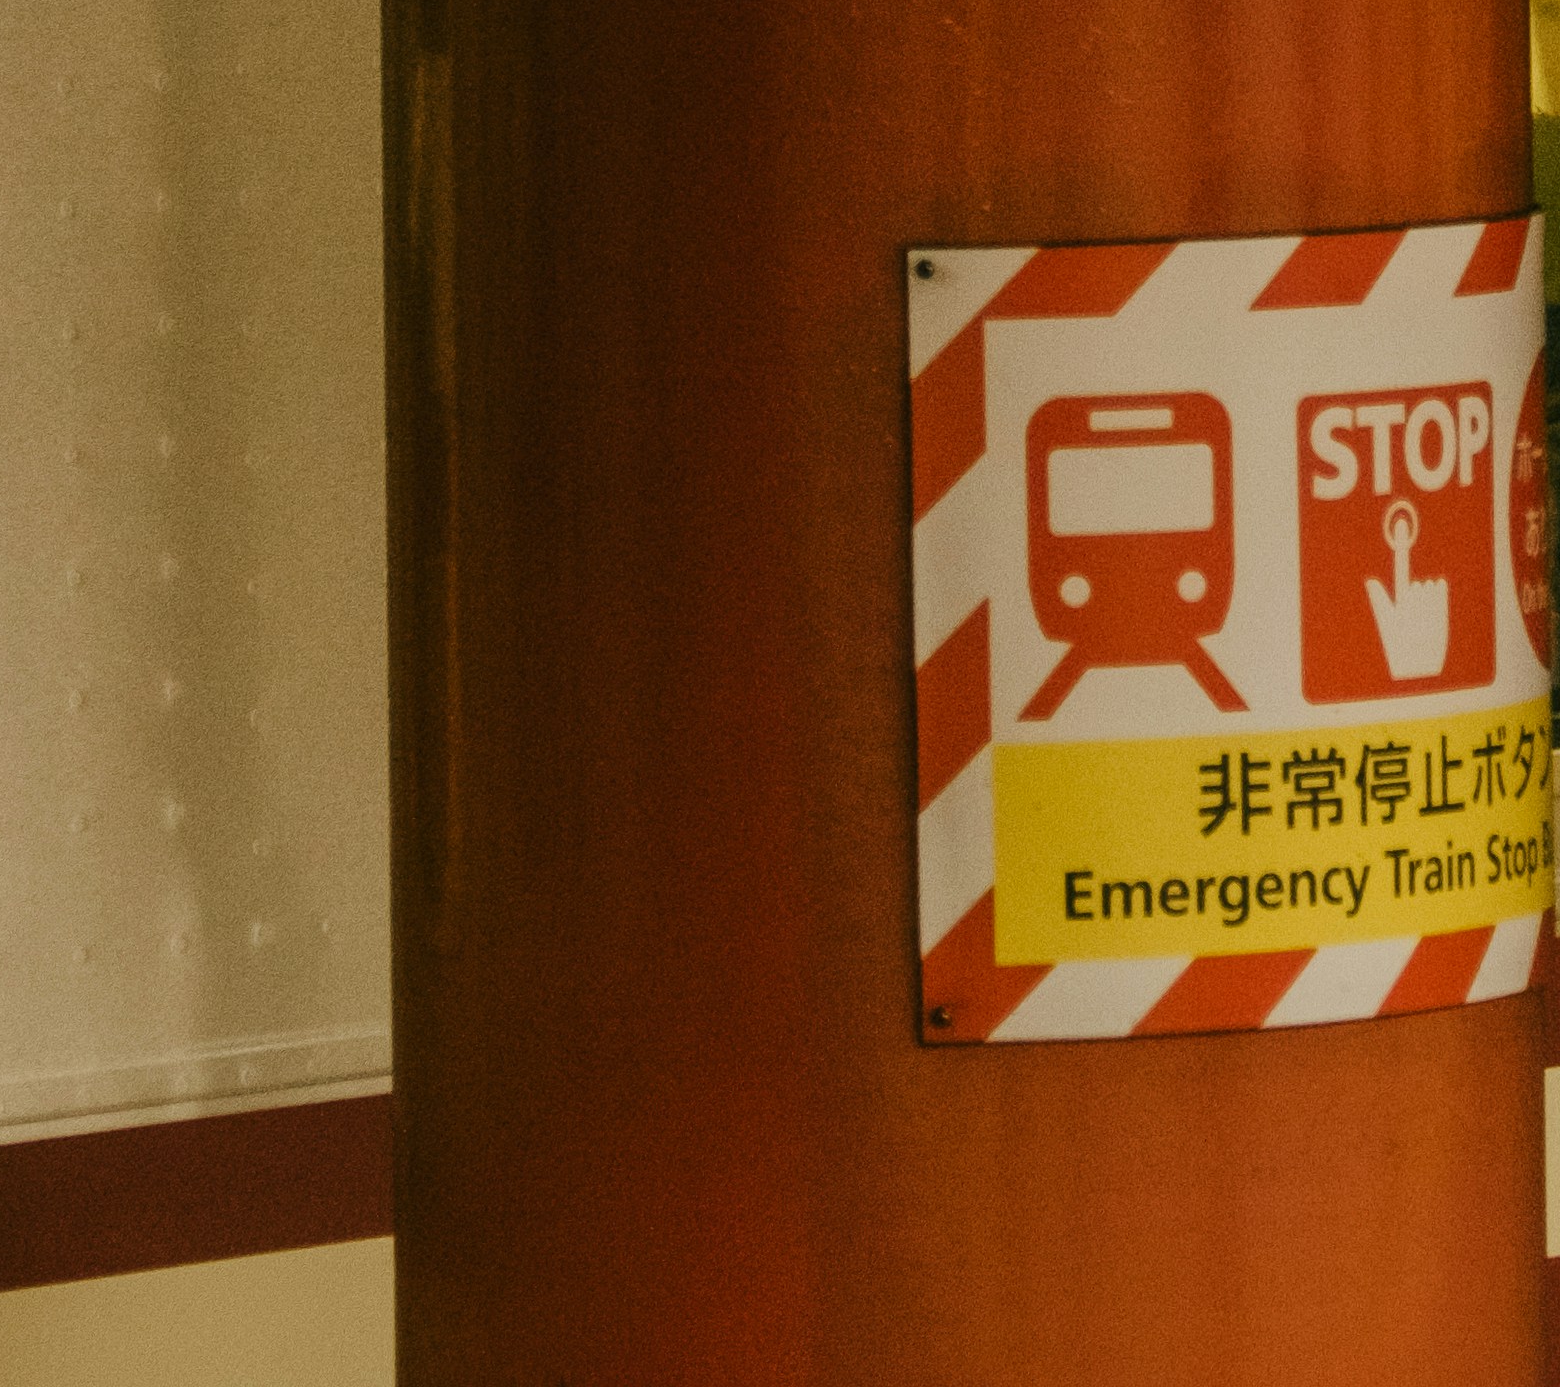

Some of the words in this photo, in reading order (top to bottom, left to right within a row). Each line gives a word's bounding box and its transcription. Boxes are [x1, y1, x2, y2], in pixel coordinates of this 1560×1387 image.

[1307, 395, 1490, 500] STOP
[1064, 862, 1371, 927] Emergency
[1384, 840, 1476, 900] Train
[1486, 832, 1539, 889] Stop
